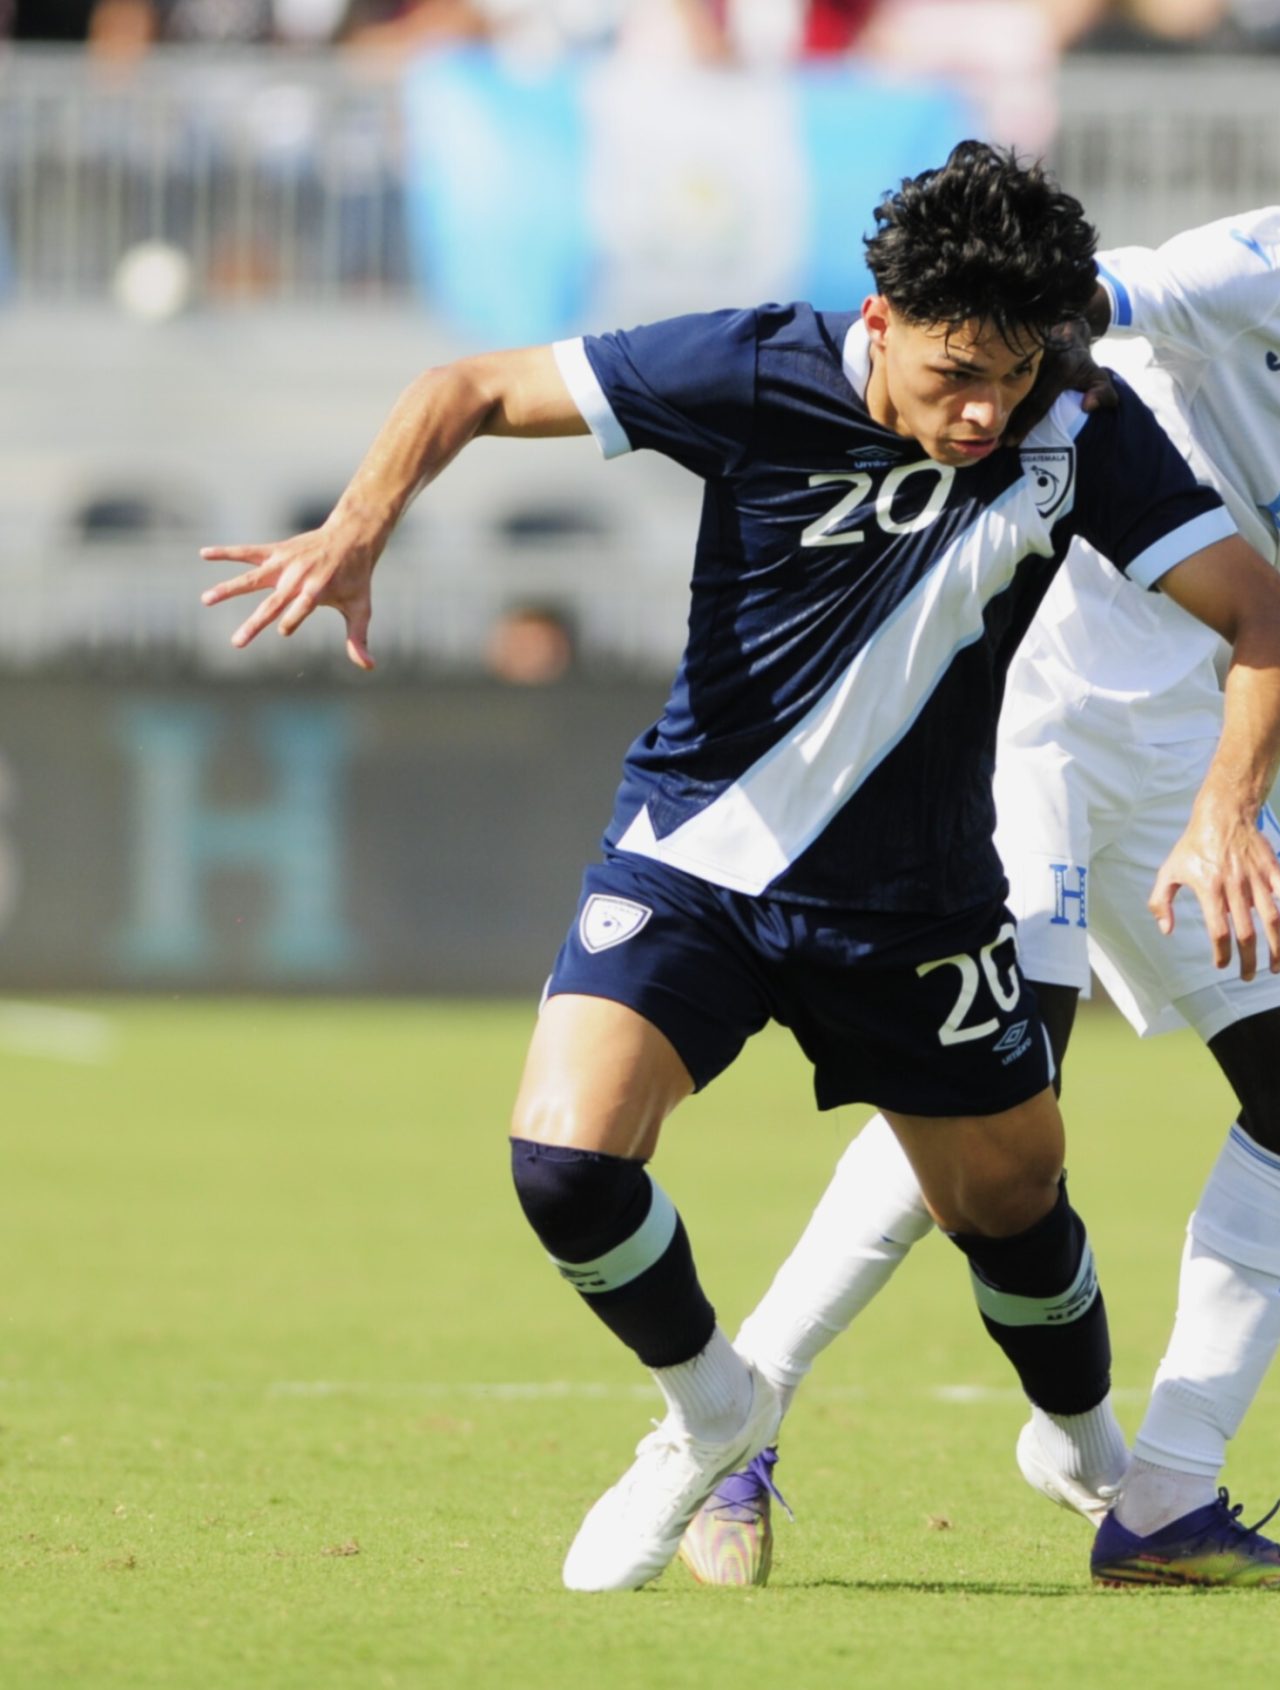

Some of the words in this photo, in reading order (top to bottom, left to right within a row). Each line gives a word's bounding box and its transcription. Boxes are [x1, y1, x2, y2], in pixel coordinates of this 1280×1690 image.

[800, 459, 955, 547] 20
[854, 460, 897, 469] umbr
[915, 923, 1021, 1047] 20
